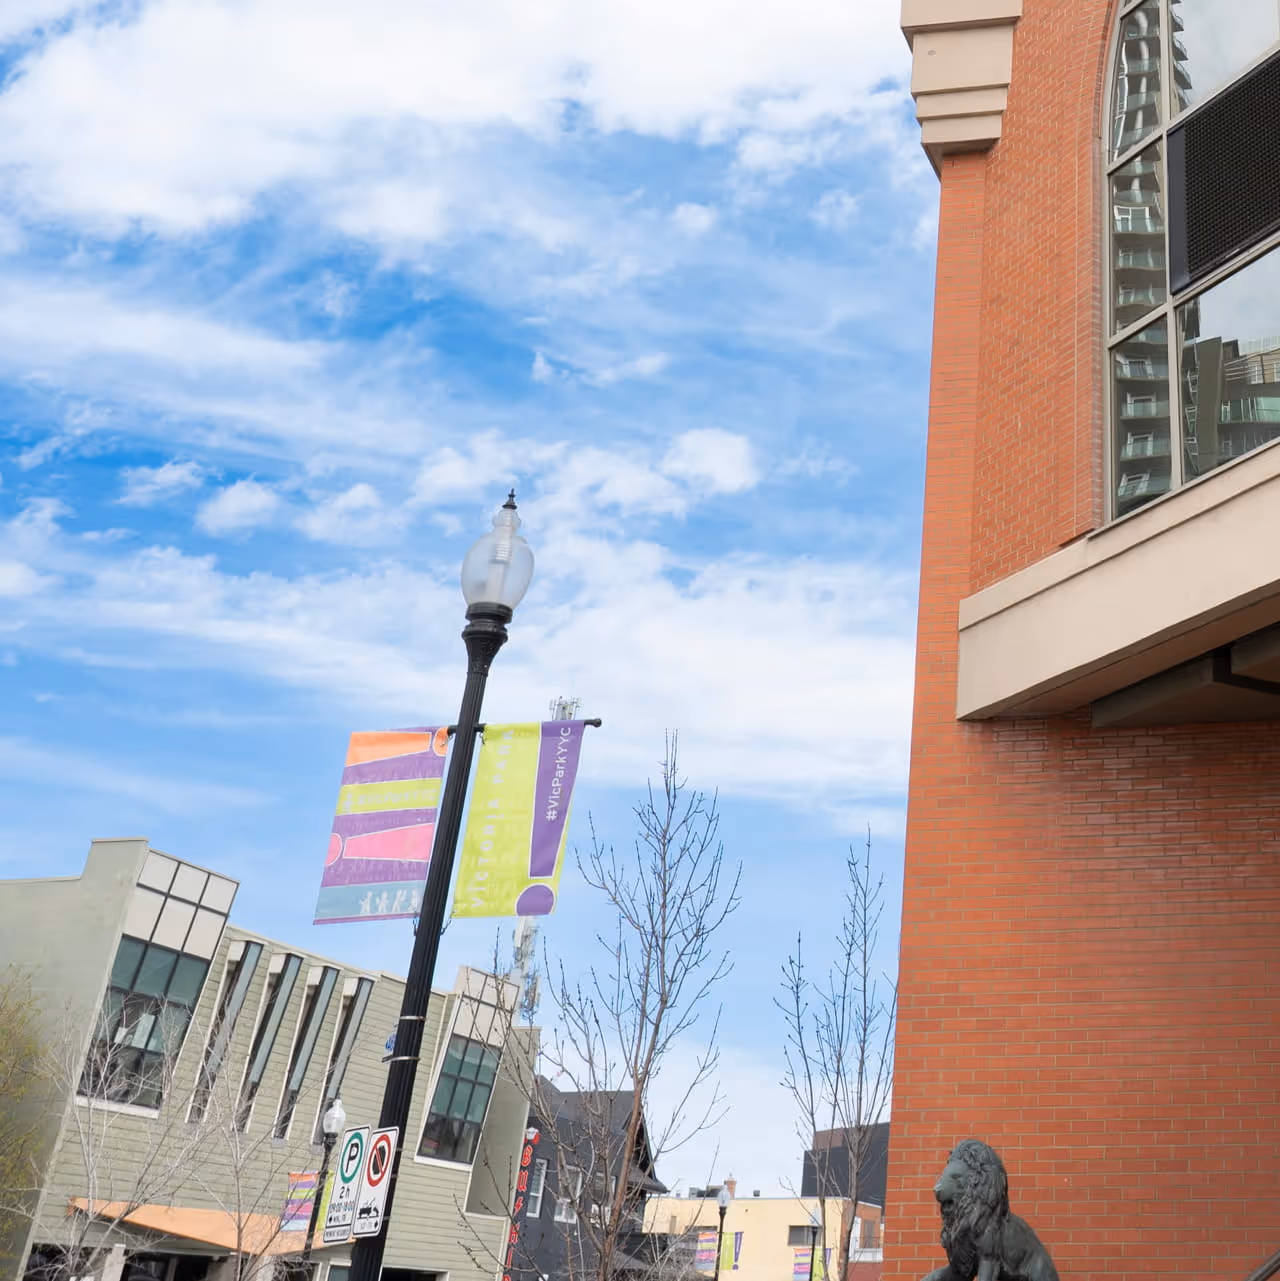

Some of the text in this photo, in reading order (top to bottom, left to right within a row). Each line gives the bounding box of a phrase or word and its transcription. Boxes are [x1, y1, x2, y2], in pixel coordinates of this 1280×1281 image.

[470, 729, 514, 908] VICTORIA PARK
[545, 726, 572, 822] #VicParkYYC
[345, 1142, 360, 1174] P
